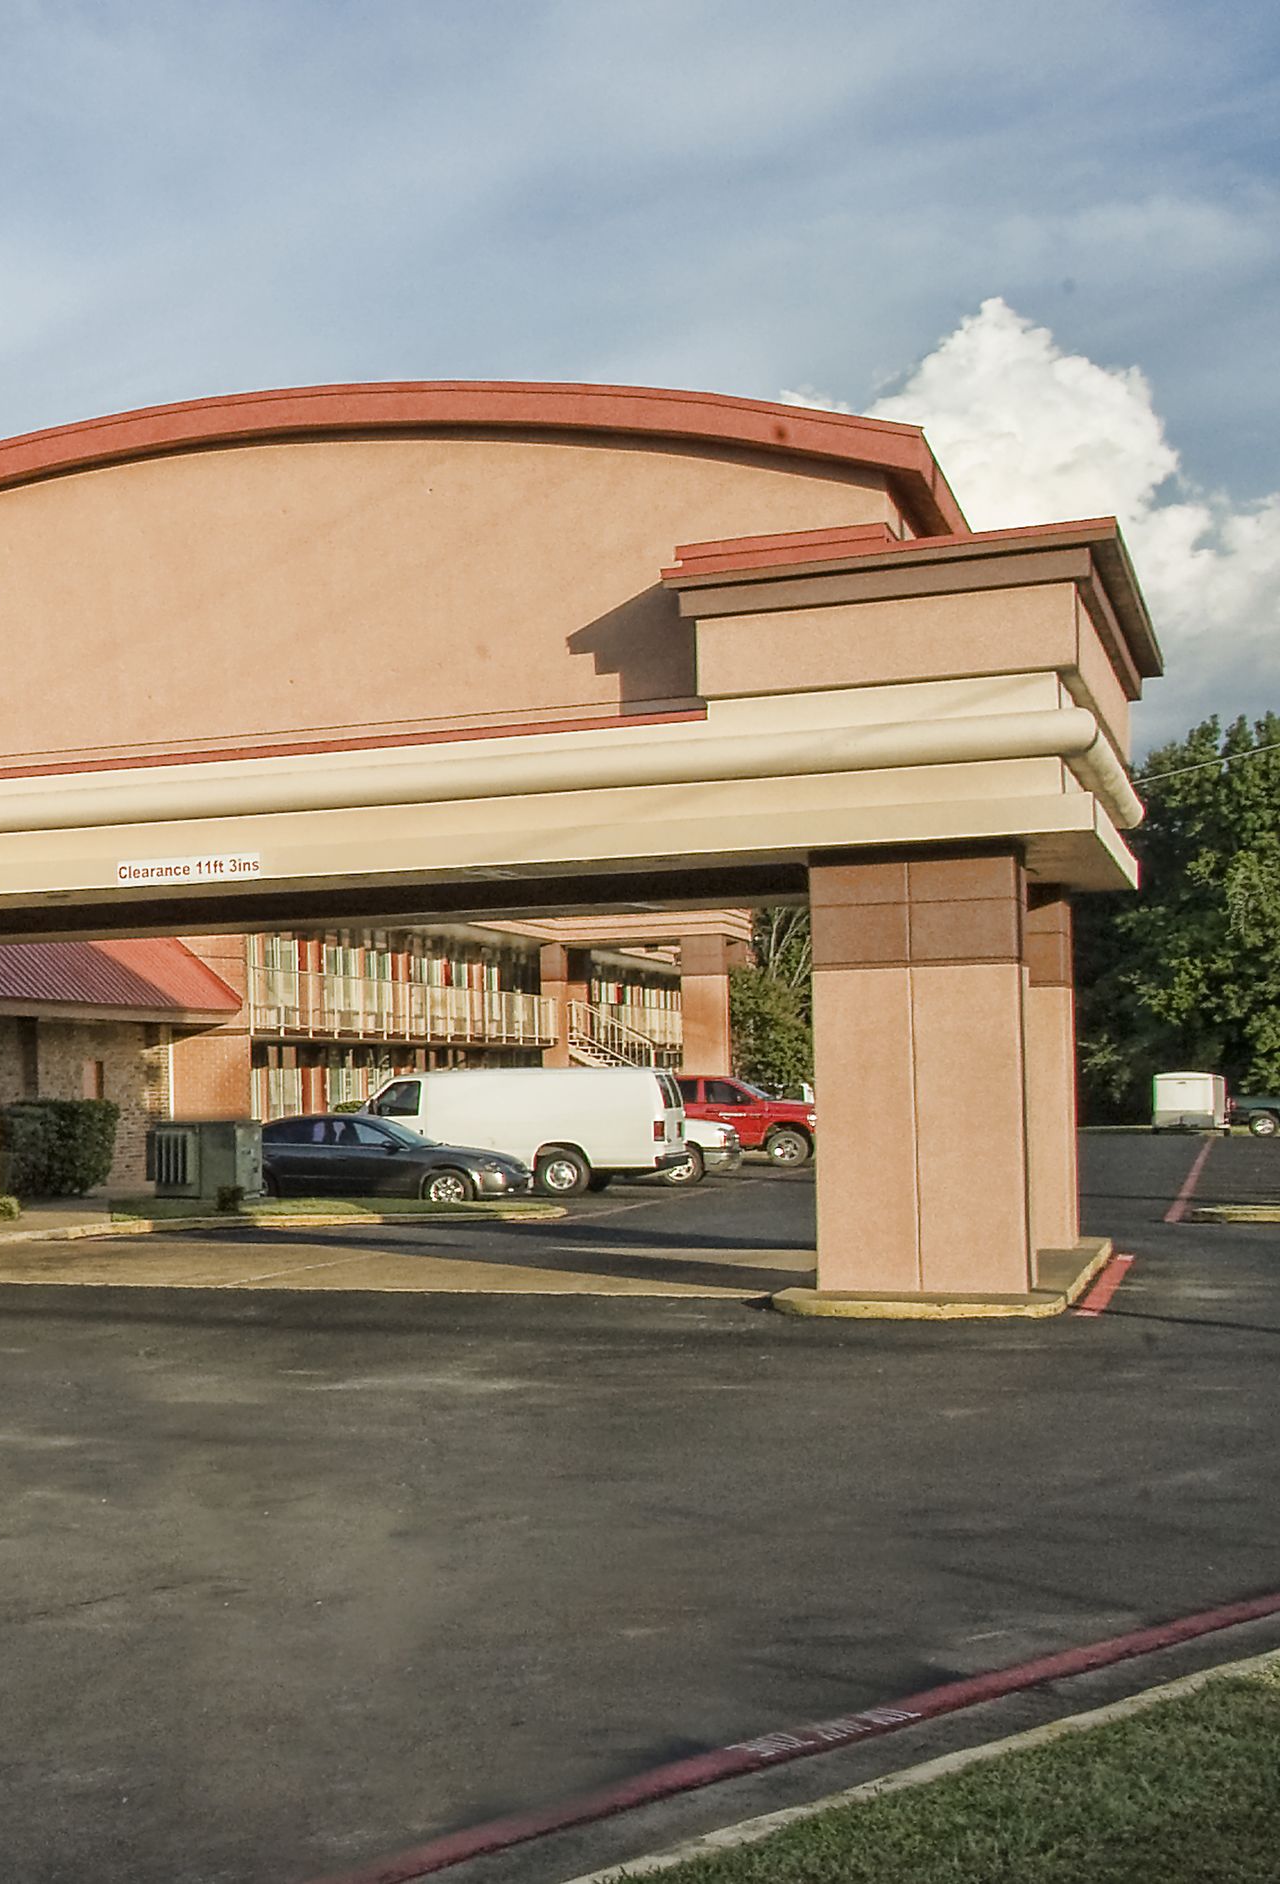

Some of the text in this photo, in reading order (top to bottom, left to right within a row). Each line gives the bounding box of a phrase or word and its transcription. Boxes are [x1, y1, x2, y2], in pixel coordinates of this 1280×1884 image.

[118, 858, 260, 879] Clearance 11ft 3ins
